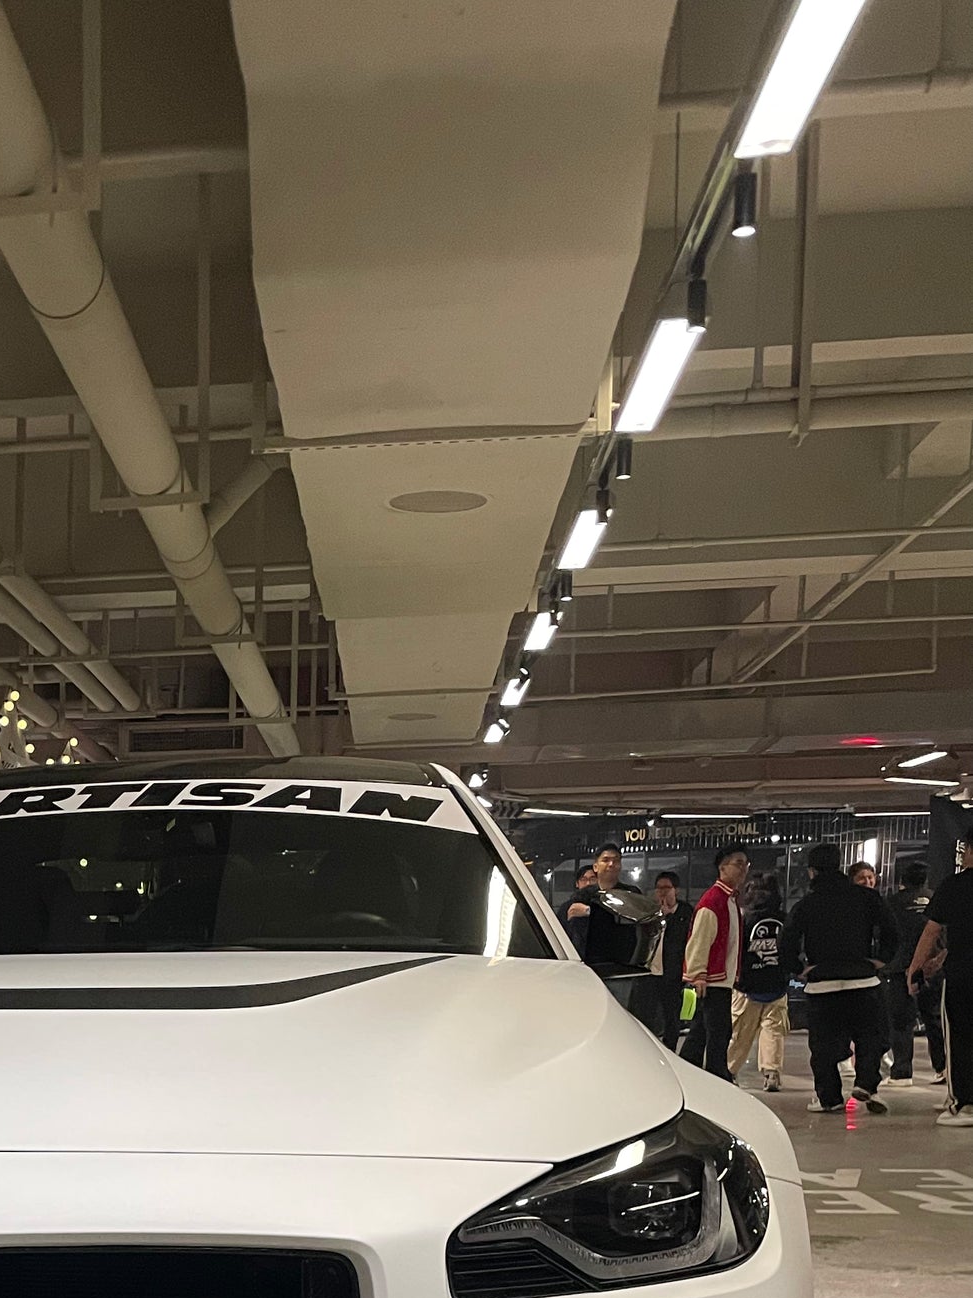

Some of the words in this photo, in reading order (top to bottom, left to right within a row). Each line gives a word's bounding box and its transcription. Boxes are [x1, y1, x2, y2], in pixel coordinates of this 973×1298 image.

[624, 829, 646, 842] YOU
[648, 826, 672, 840] NEED
[675, 823, 759, 838] PROFESSIONAL
